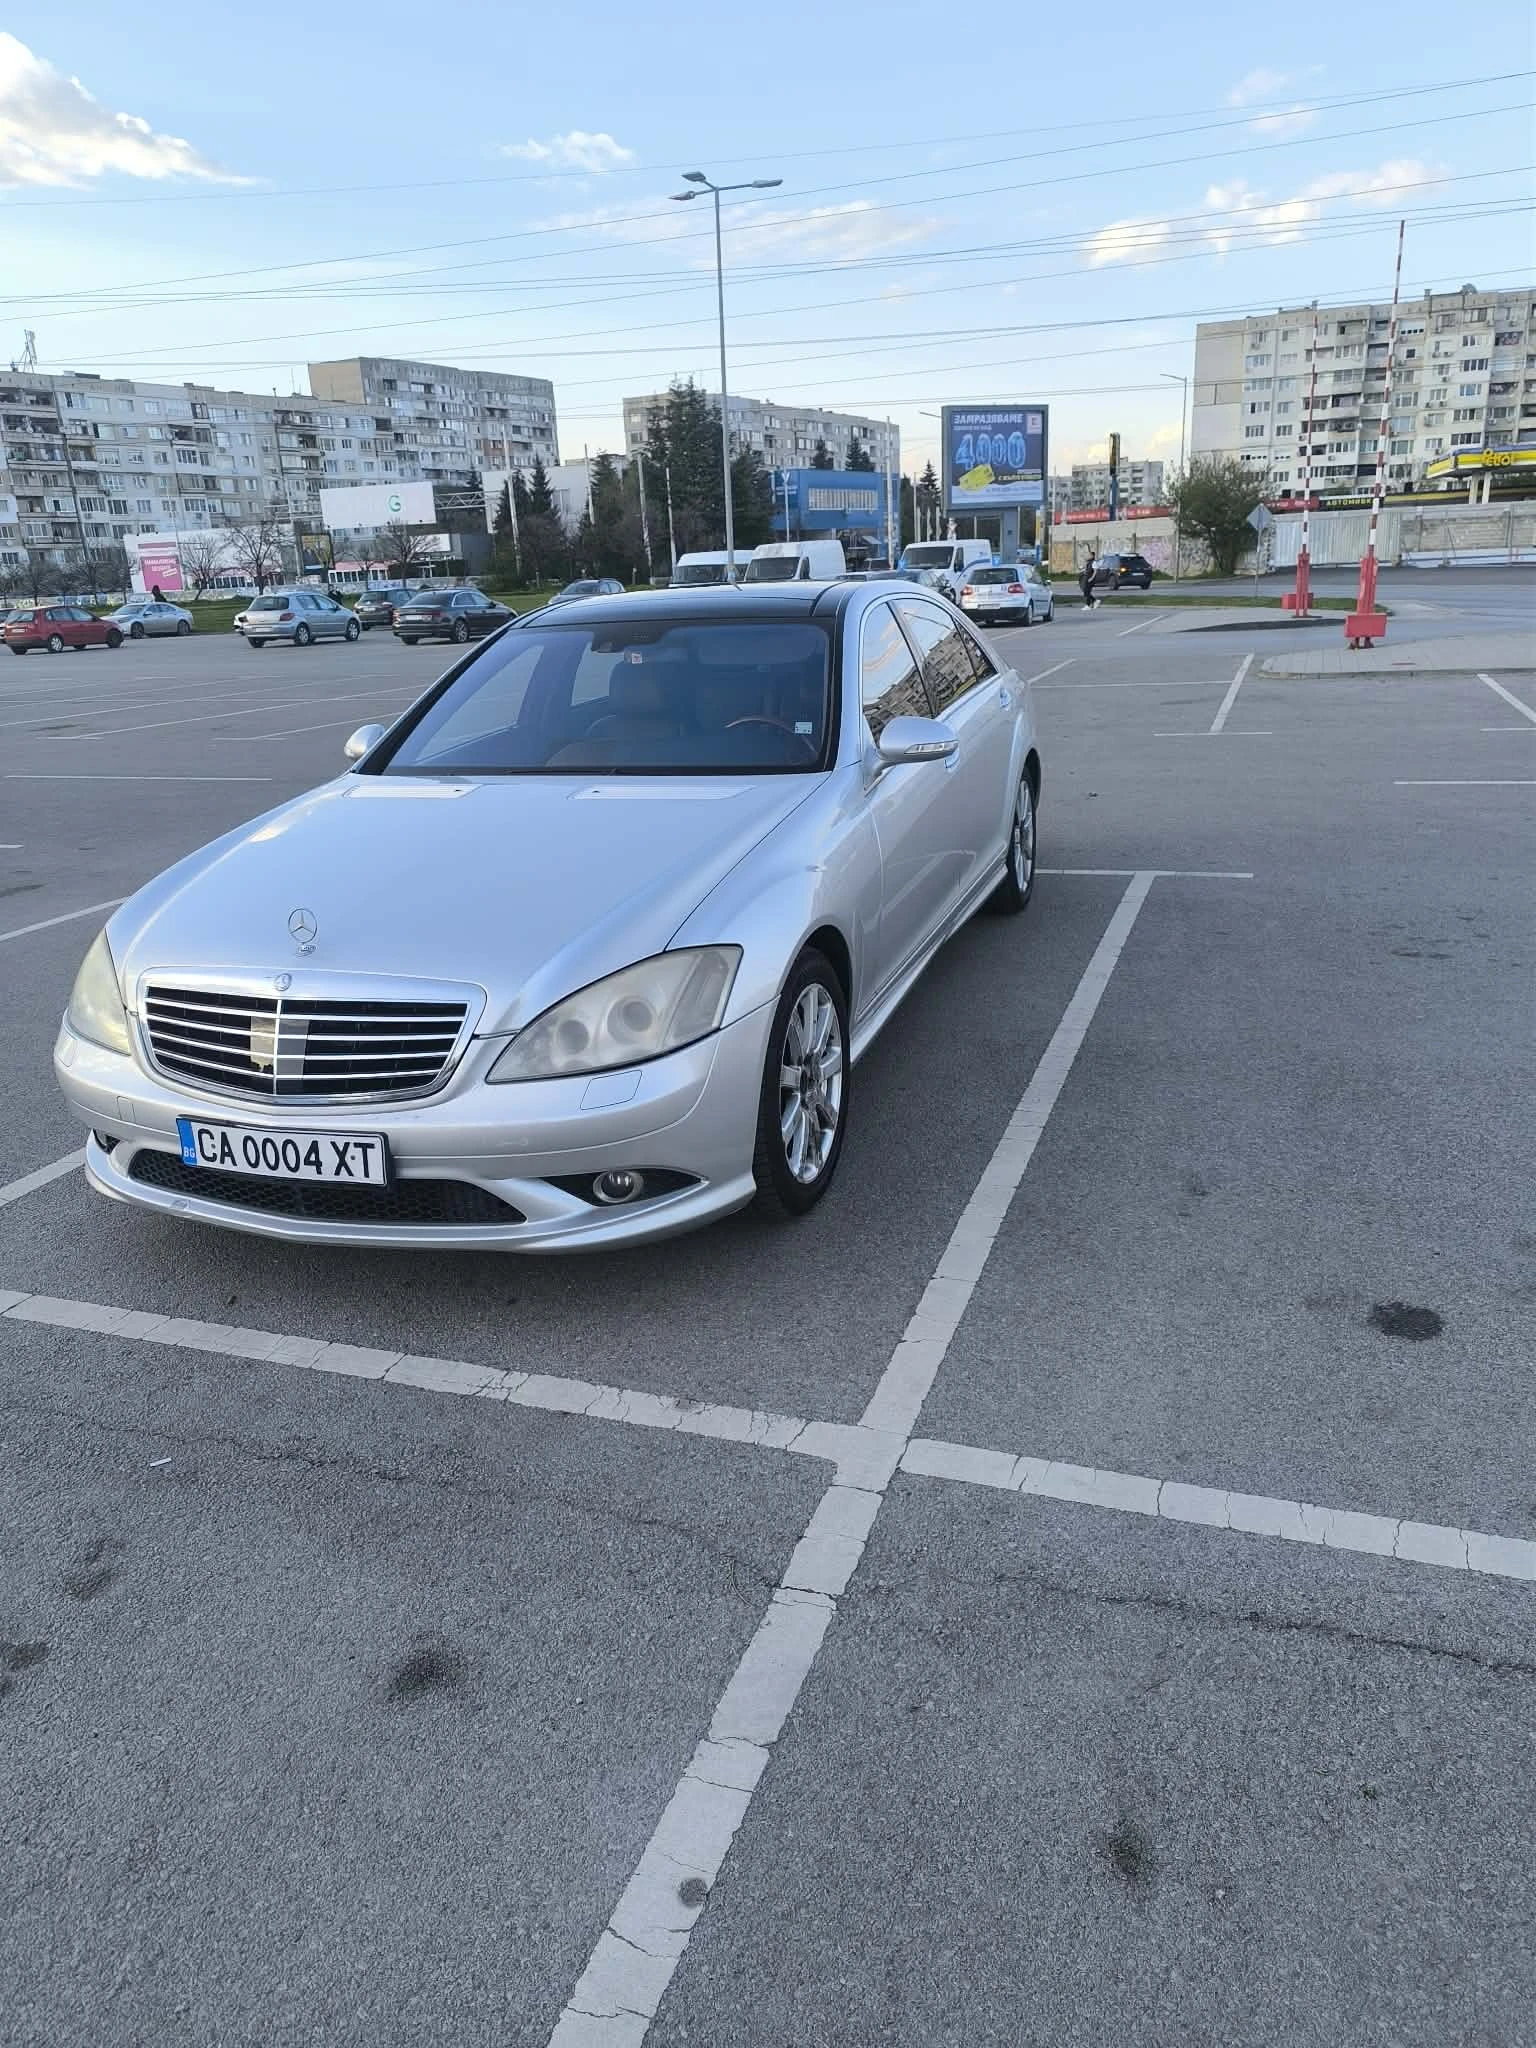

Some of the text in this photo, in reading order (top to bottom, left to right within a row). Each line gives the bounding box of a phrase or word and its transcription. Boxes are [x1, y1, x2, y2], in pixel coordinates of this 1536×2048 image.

[955, 431, 1026, 470] 4000
[183, 1147, 196, 1159] BG
[197, 1128, 375, 1178] CA 0004 XT
